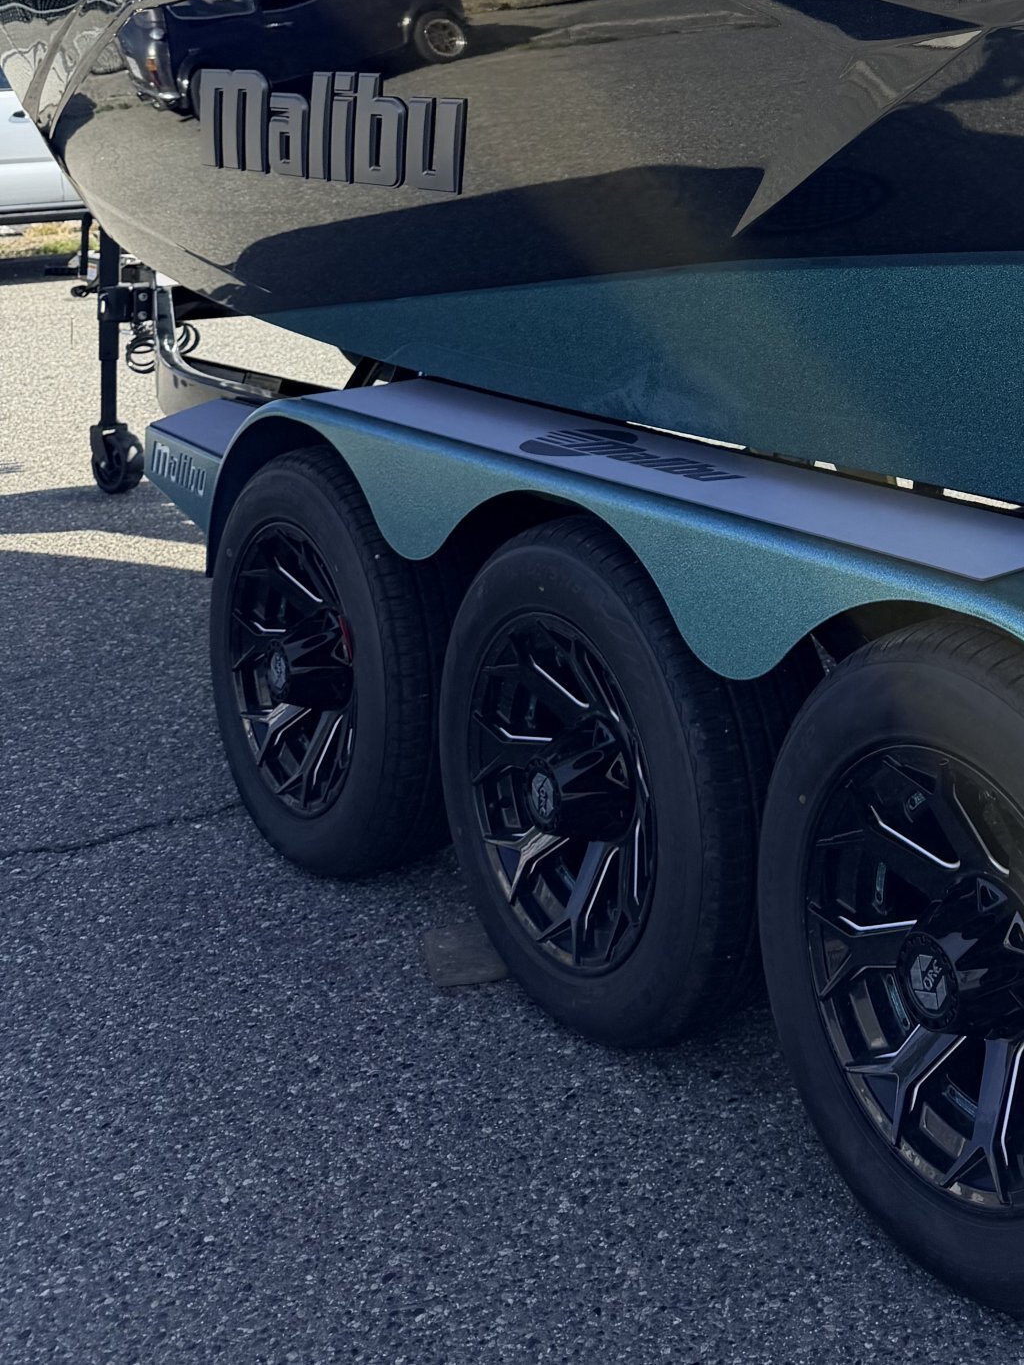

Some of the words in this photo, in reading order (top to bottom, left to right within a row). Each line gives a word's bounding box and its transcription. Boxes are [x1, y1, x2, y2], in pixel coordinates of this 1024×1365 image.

[200, 69, 468, 195] Malibu
[152, 441, 207, 496] Malibu
[560, 439, 748, 482] Malibu
